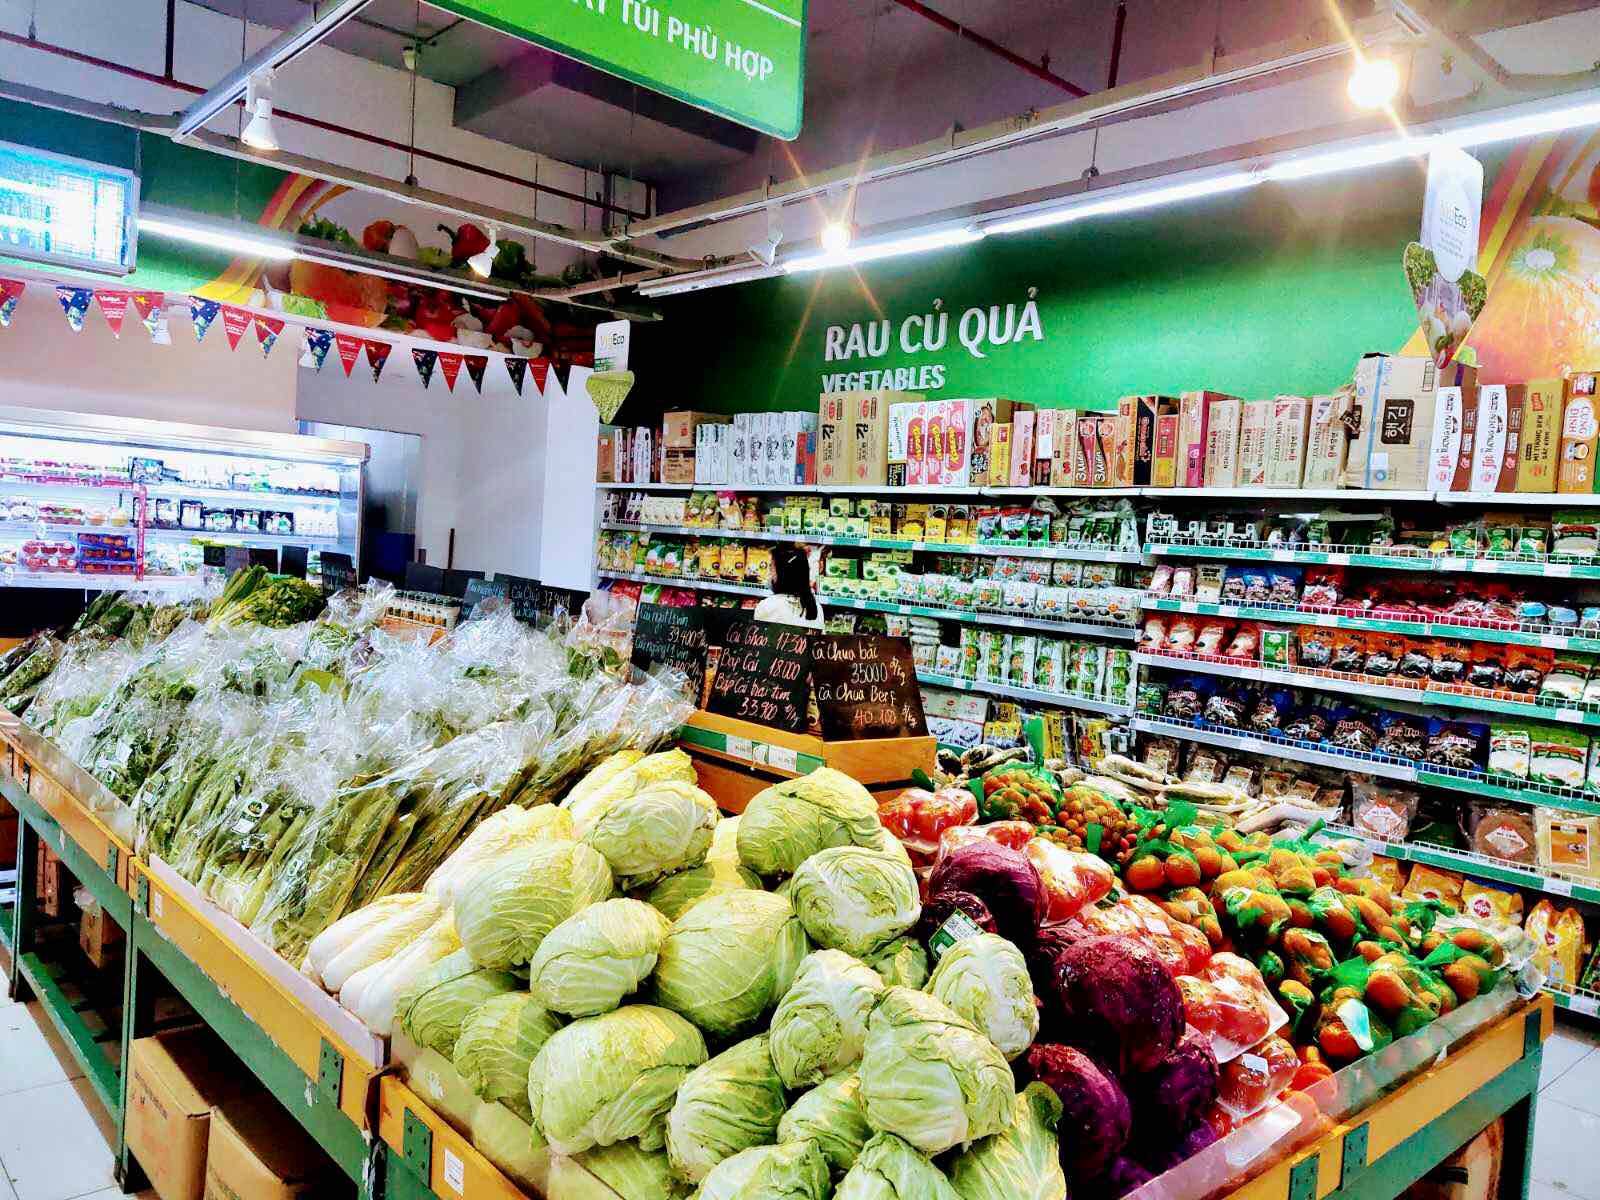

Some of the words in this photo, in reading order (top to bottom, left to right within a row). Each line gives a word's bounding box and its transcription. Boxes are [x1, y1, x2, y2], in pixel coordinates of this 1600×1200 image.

[667, 16, 718, 60] PHÙ
[724, 41, 775, 81] HỢP
[824, 319, 891, 361] RAU
[900, 298, 949, 354] CỦ
[958, 287, 1044, 358] QUẢ
[821, 364, 946, 393] VEGETABLES
